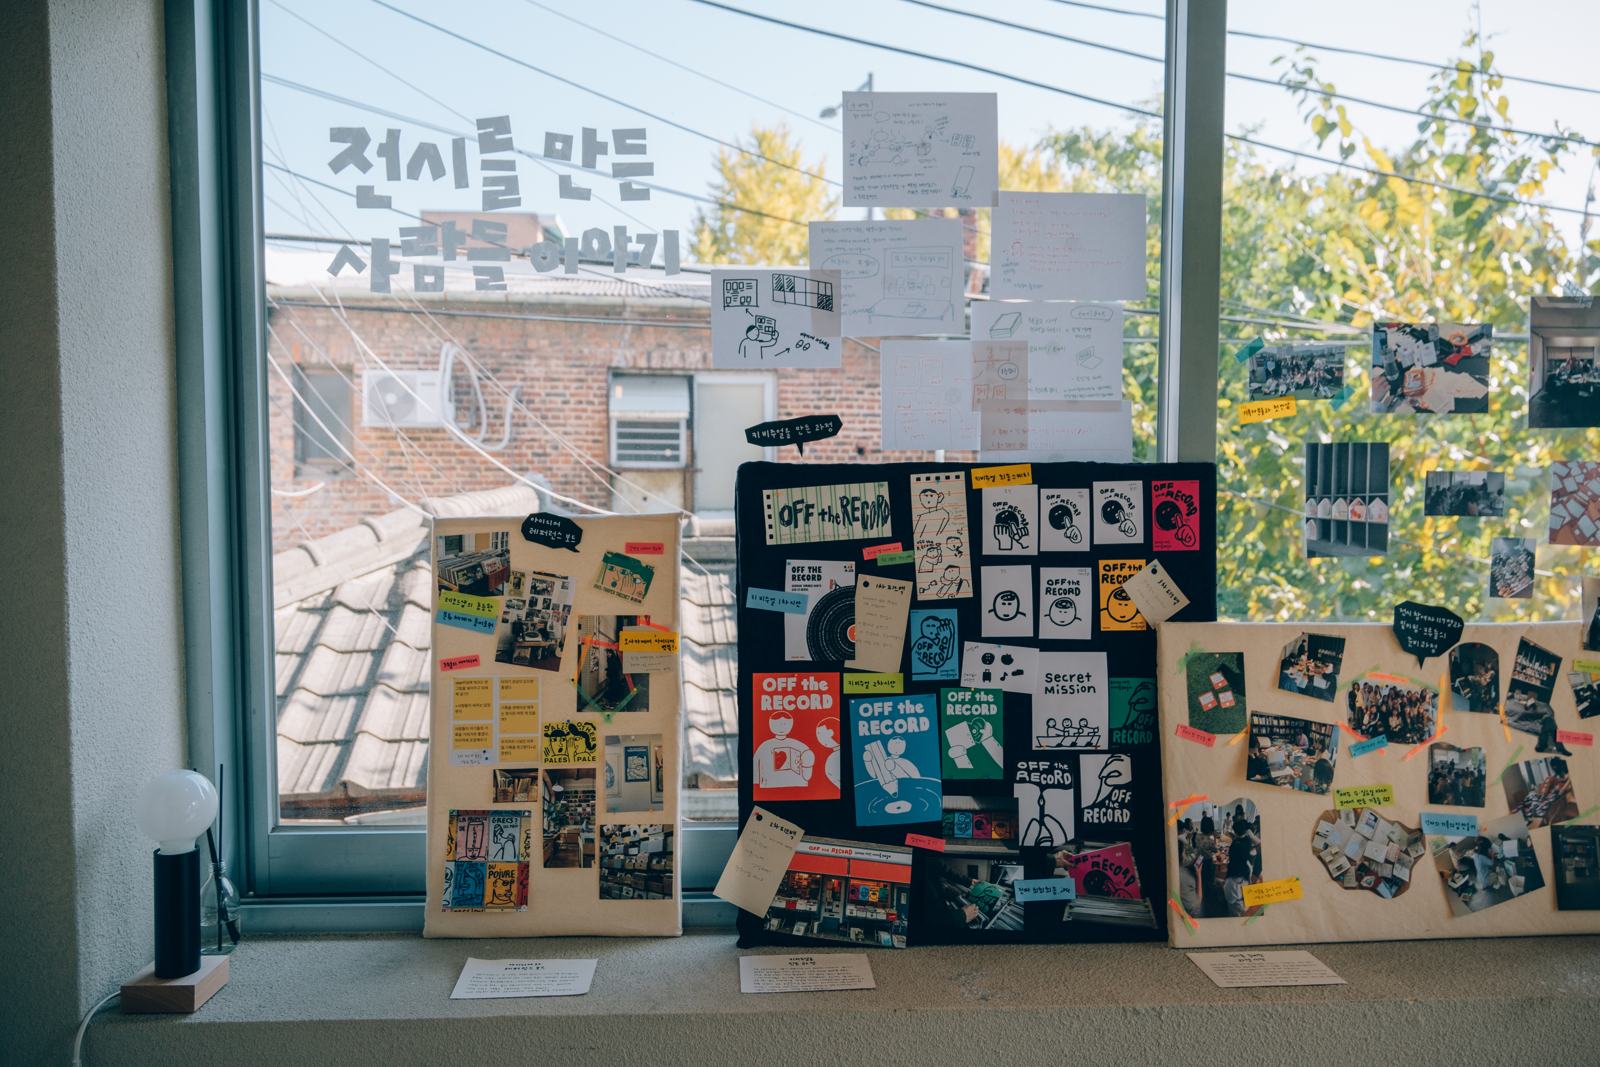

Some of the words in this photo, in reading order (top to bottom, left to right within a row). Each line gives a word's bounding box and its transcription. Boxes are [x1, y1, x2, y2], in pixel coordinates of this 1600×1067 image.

[327, 113, 521, 210] 전시를
[544, 124, 654, 200] 만든
[326, 217, 511, 293] 사람들
[530, 224, 680, 276] 이야기
[814, 421, 833, 432] 과정
[1153, 483, 1174, 492] OFF
[779, 498, 815, 529] OFF
[818, 505, 841, 526] the
[840, 494, 891, 531] RECORD
[791, 566, 805, 574] OFF
[807, 566, 822, 574] THE
[1102, 563, 1126, 572] OFF
[1127, 563, 1143, 572] the
[791, 574, 822, 582] RECORD
[1046, 578, 1067, 586] OFF
[1067, 578, 1080, 586] the
[1045, 586, 1081, 597] RECORD
[917, 641, 933, 651] OFF
[922, 636, 949, 665] RECORD
[762, 676, 797, 692] OFF
[801, 676, 829, 691] the
[1045, 672, 1092, 683] Secret
[761, 693, 833, 711] RECORD
[947, 691, 972, 702] OFF
[974, 690, 994, 702] the
[858, 701, 894, 718] OFF
[897, 699, 925, 714] the
[946, 703, 998, 716] RECORD
[1139, 713, 1154, 725] OFF
[858, 716, 930, 737] RECORD
[1112, 730, 1153, 744] RECORD
[1017, 761, 1050, 771] OFF
[1053, 762, 1069, 770] the
[1016, 770, 1071, 785] RECORD
[1111, 788, 1132, 803] OFF
[1105, 799, 1120, 808] the
[1083, 807, 1131, 824] RECORD
[1091, 858, 1136, 887] RECORD
